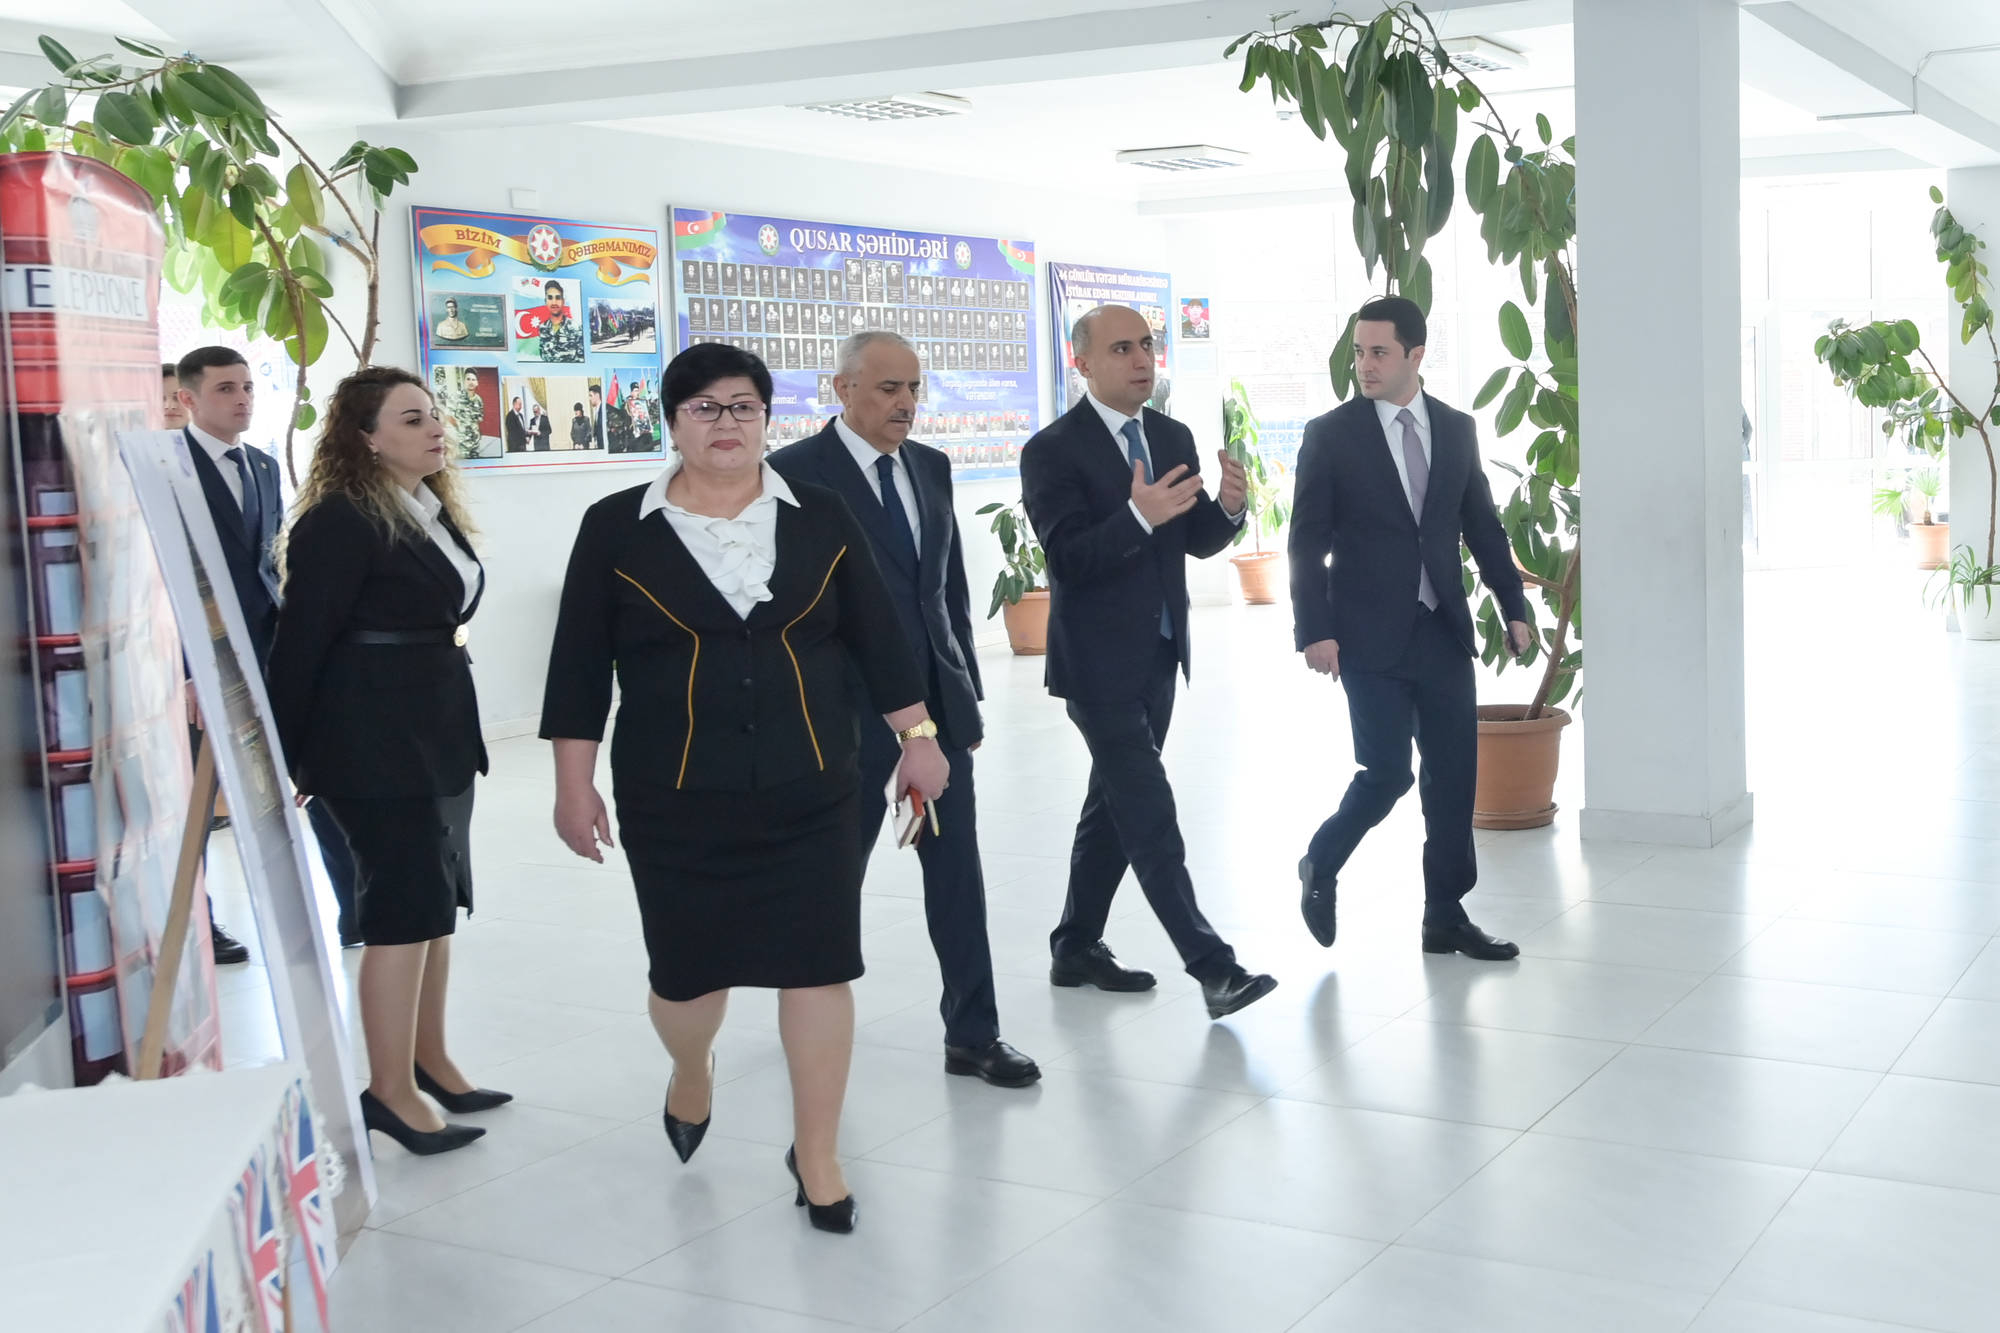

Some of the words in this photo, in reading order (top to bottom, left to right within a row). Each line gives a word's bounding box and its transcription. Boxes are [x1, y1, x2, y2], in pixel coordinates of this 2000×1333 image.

[455, 228, 502, 248] BİZİM
[789, 228, 853, 253] QUSAR
[856, 231, 949, 259] ŞƏHİDLƏRİ
[4, 268, 144, 317] ELEPHONE
